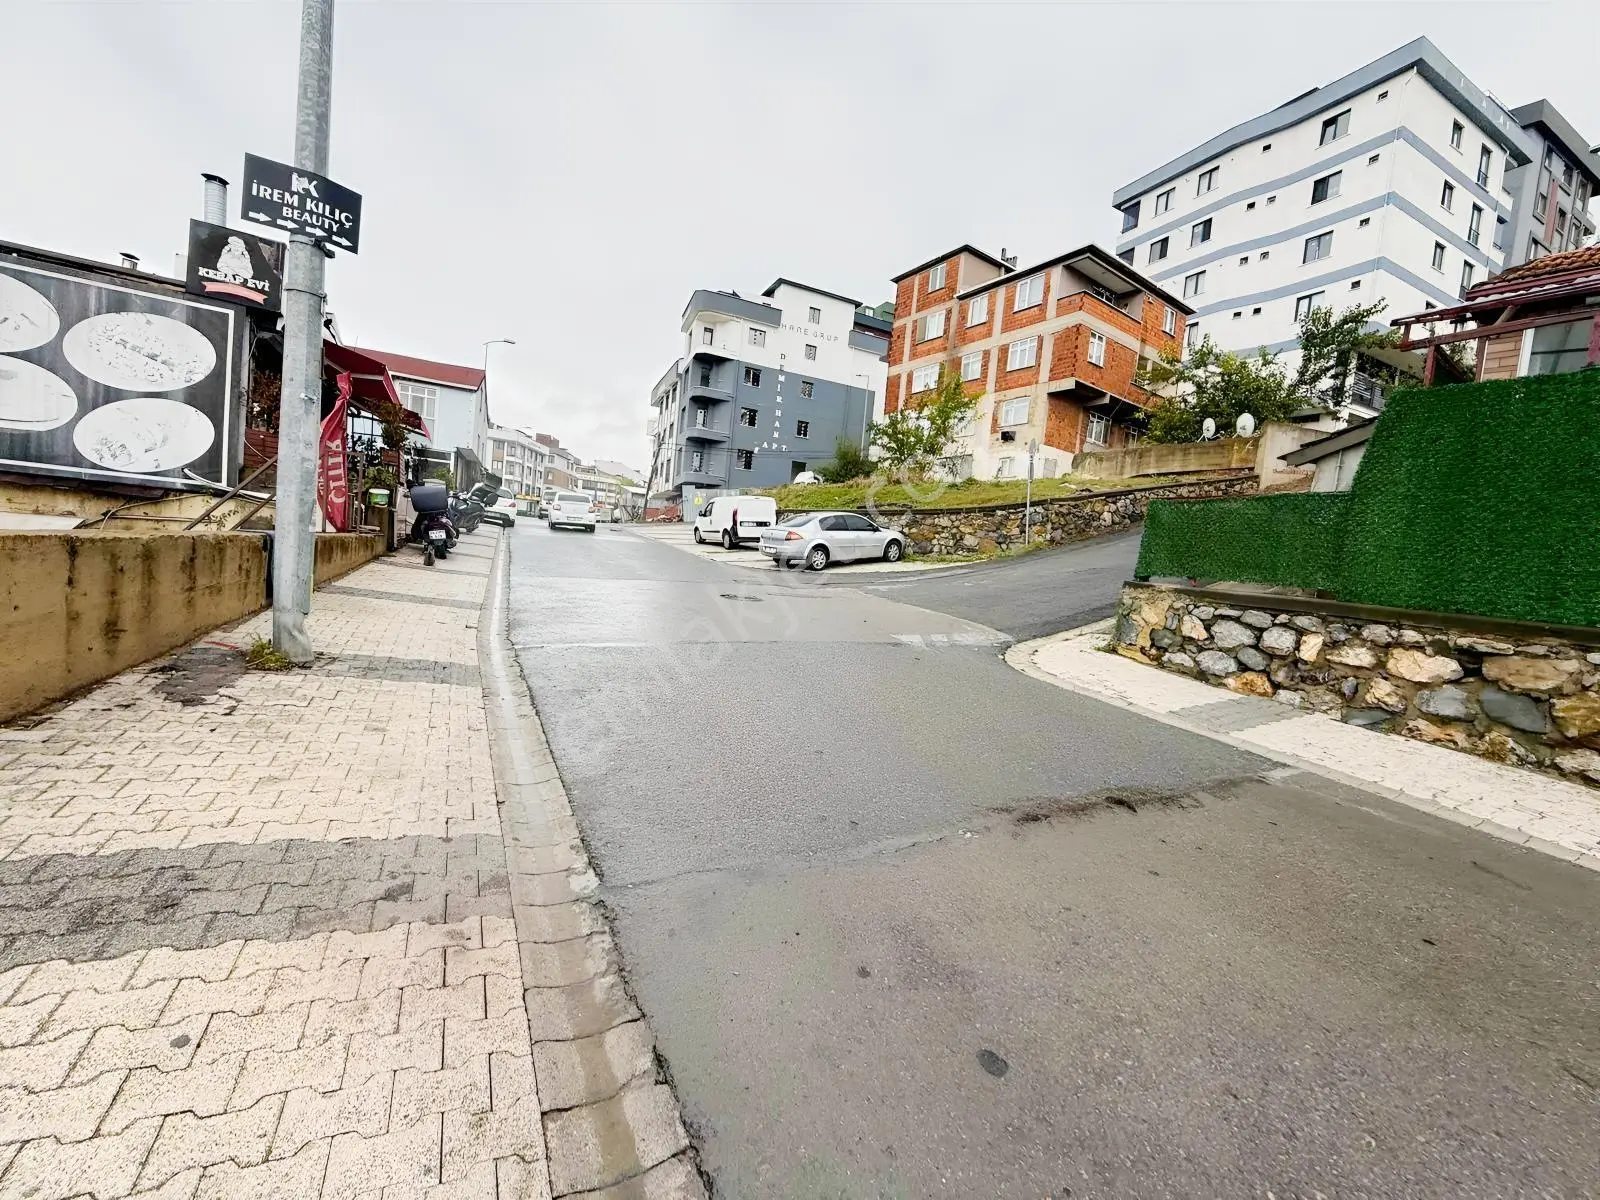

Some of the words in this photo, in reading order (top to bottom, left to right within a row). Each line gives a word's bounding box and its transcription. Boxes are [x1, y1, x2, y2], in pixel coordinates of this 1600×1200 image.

[251, 179, 299, 208] İREM
[306, 197, 353, 228] KILIÇ
[282, 206, 340, 232] BEAUTY
[198, 266, 244, 284] KEBAP
[246, 278, 270, 292] EVİ
